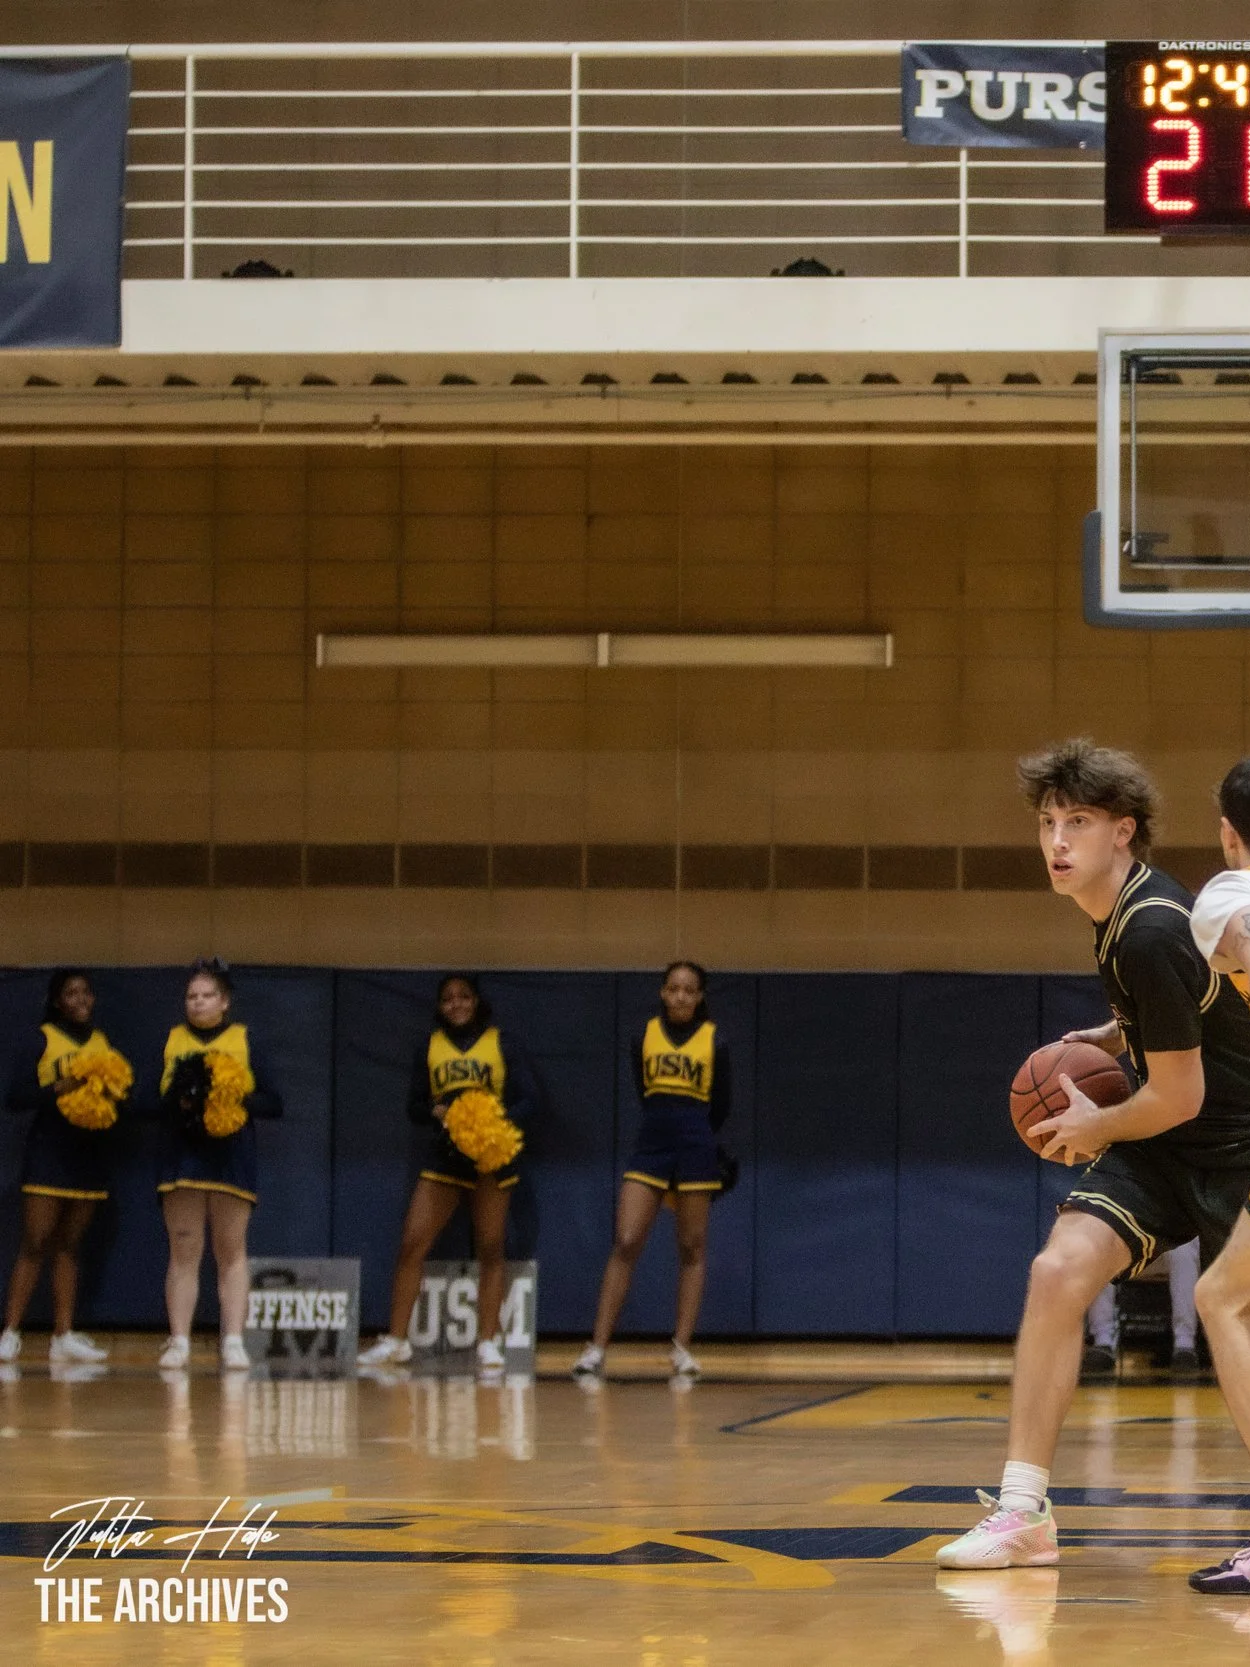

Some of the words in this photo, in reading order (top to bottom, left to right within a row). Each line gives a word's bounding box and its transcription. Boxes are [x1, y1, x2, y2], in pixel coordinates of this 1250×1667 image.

[914, 69, 1106, 123] PURS
[433, 1058, 493, 1089] USM
[643, 1053, 703, 1087] USM
[245, 1290, 348, 1330] FFENSE
